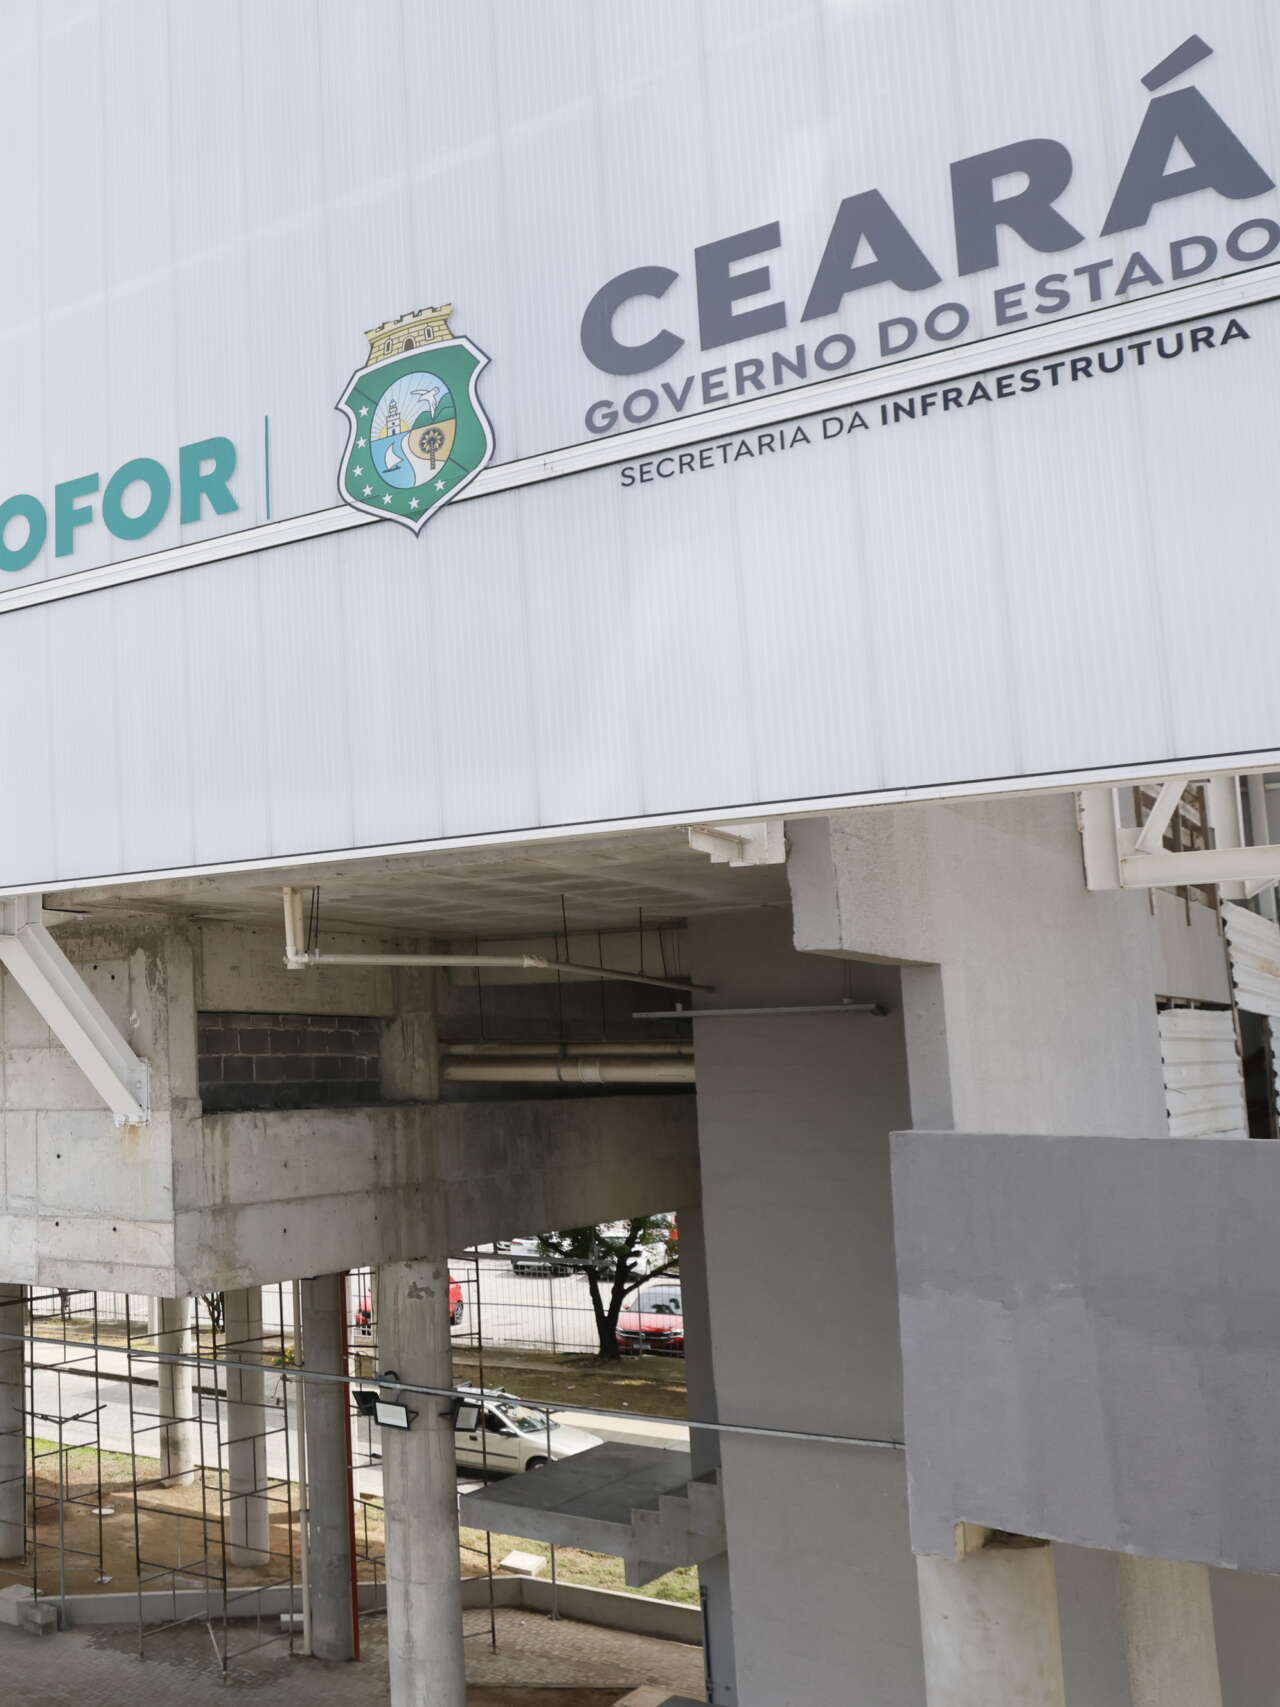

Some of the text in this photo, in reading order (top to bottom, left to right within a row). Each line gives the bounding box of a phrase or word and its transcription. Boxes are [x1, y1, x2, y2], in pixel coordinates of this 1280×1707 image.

[580, 33, 1277, 377] CEARÁ
[584, 217, 1280, 435] GOVERNO DO ESTADO
[620, 318, 1252, 488] SECRETARIA DA INFRAESTRUTURA
